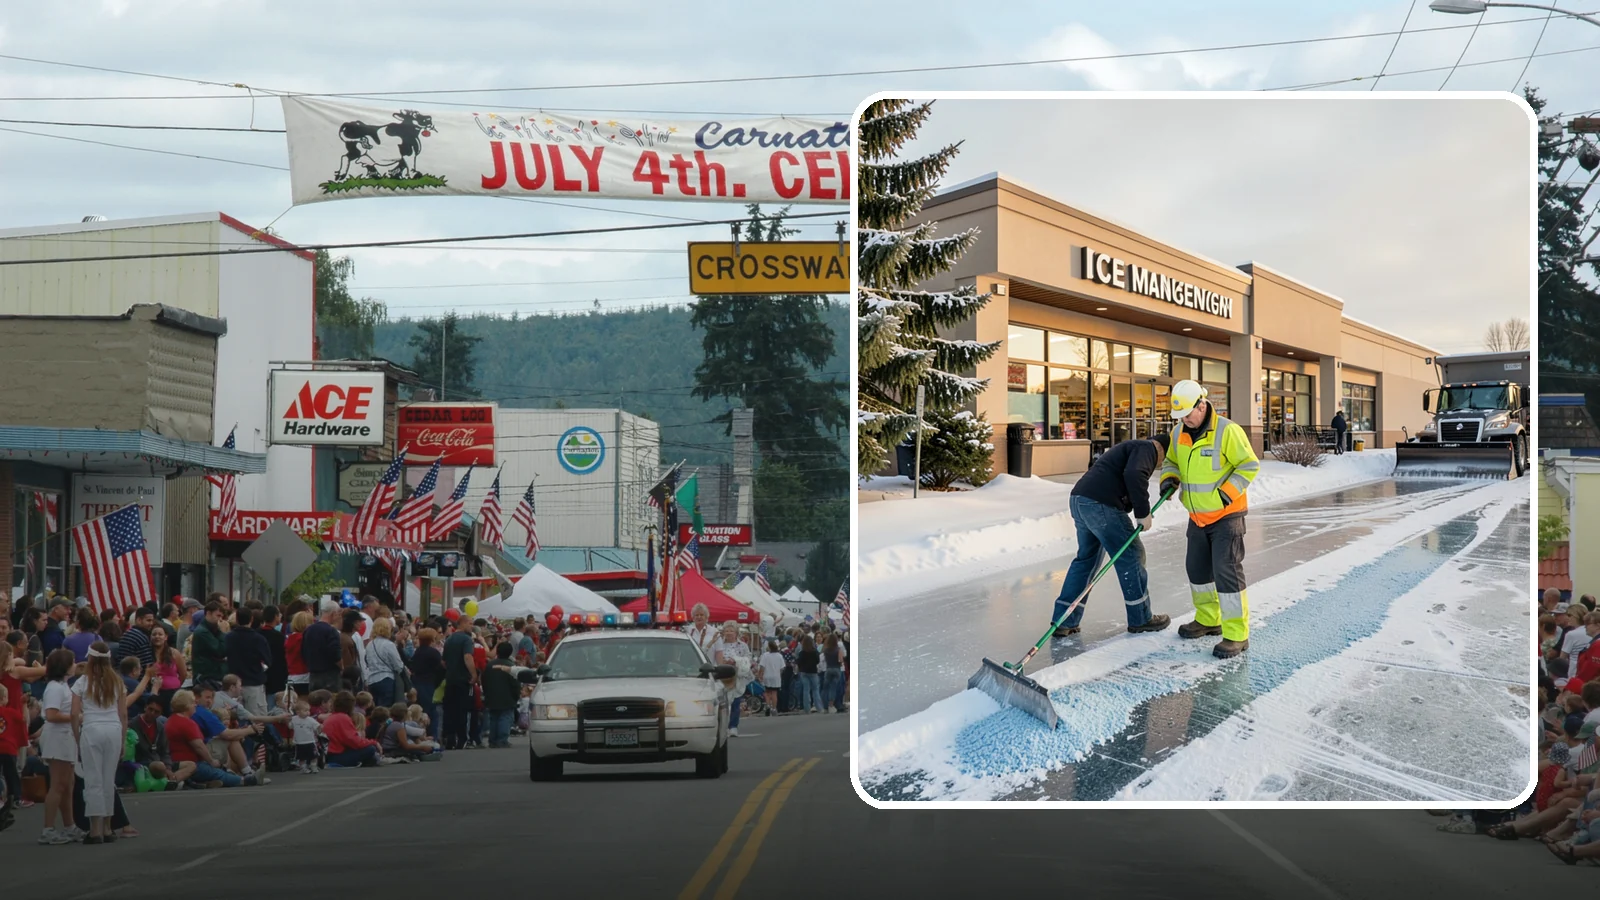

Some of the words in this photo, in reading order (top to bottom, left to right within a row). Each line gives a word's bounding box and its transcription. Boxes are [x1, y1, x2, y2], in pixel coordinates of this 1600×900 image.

[695, 121, 850, 150] Carnat
[481, 141, 605, 192] JULY
[633, 150, 746, 197] 4th.
[697, 254, 850, 280] CROSSWA
[1083, 246, 1125, 289] ICE
[283, 380, 373, 420] ACE
[405, 409, 453, 421] CEDAR
[461, 410, 485, 421] LOG
[283, 421, 371, 436] Hardware
[354, 467, 385, 480] Simpl
[95, 485, 124, 494] Vincent
[126, 486, 136, 495] de
[138, 486, 155, 495] Paul
[688, 526, 741, 535] CRNATION
[699, 535, 730, 543] GLASS
